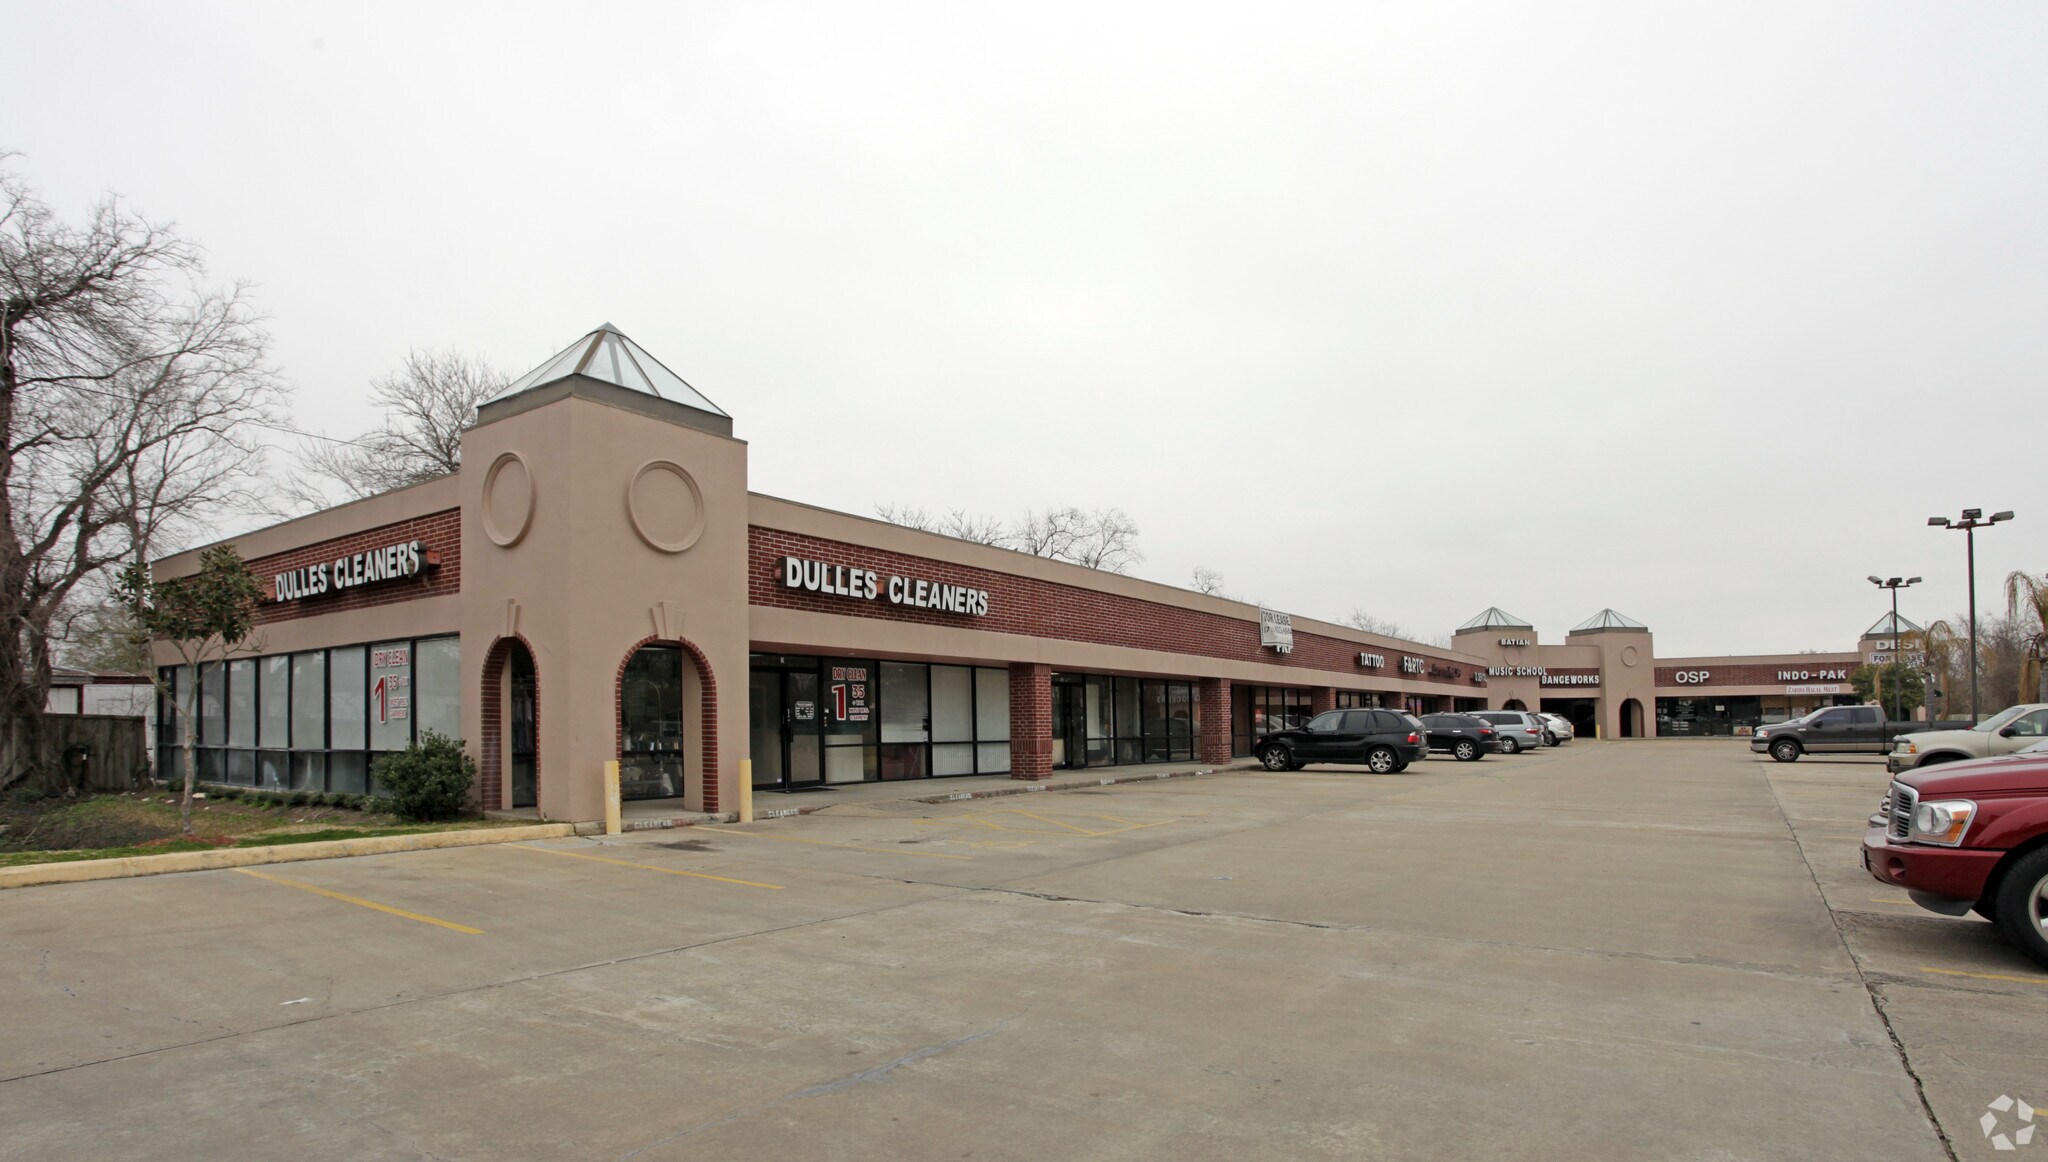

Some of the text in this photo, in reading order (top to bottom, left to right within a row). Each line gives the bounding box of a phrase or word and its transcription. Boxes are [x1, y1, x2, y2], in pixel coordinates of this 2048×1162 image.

[275, 540, 420, 602] DULLES CLEANERS
[786, 556, 989, 616] DULLES CLEANERS
[1360, 652, 1385, 669] TATTOO
[832, 667, 867, 681] DRY CLEAN
[1488, 666, 1547, 676] MUSIC SCHOOL
[1675, 671, 1710, 683] OSP
[1541, 675, 1600, 685] DANCEWORKS
[852, 684, 865, 698] 35
[373, 675, 386, 724] 1
[831, 684, 846, 720] 1
